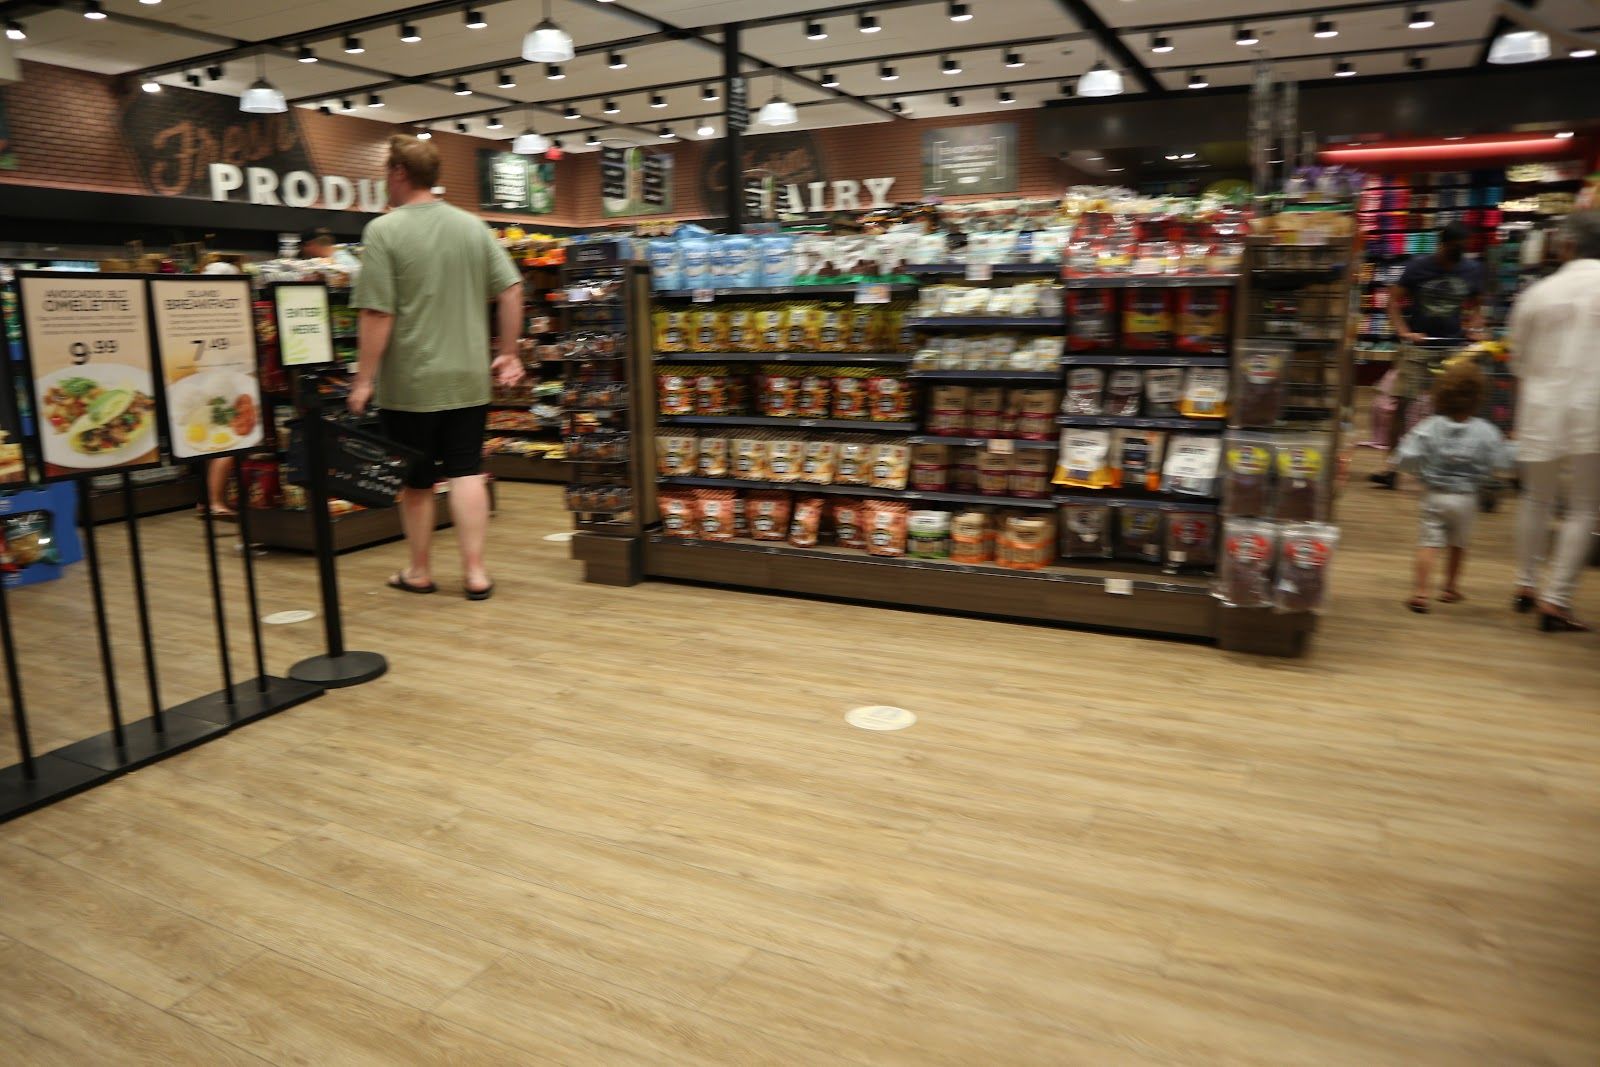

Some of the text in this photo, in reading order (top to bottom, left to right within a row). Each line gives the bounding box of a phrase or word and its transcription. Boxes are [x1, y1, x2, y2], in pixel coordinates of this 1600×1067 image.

[209, 163, 446, 213] PRODU
[783, 177, 897, 214] AIRY
[42, 299, 130, 312] OMELETTE
[163, 298, 240, 310] BREAKFAST
